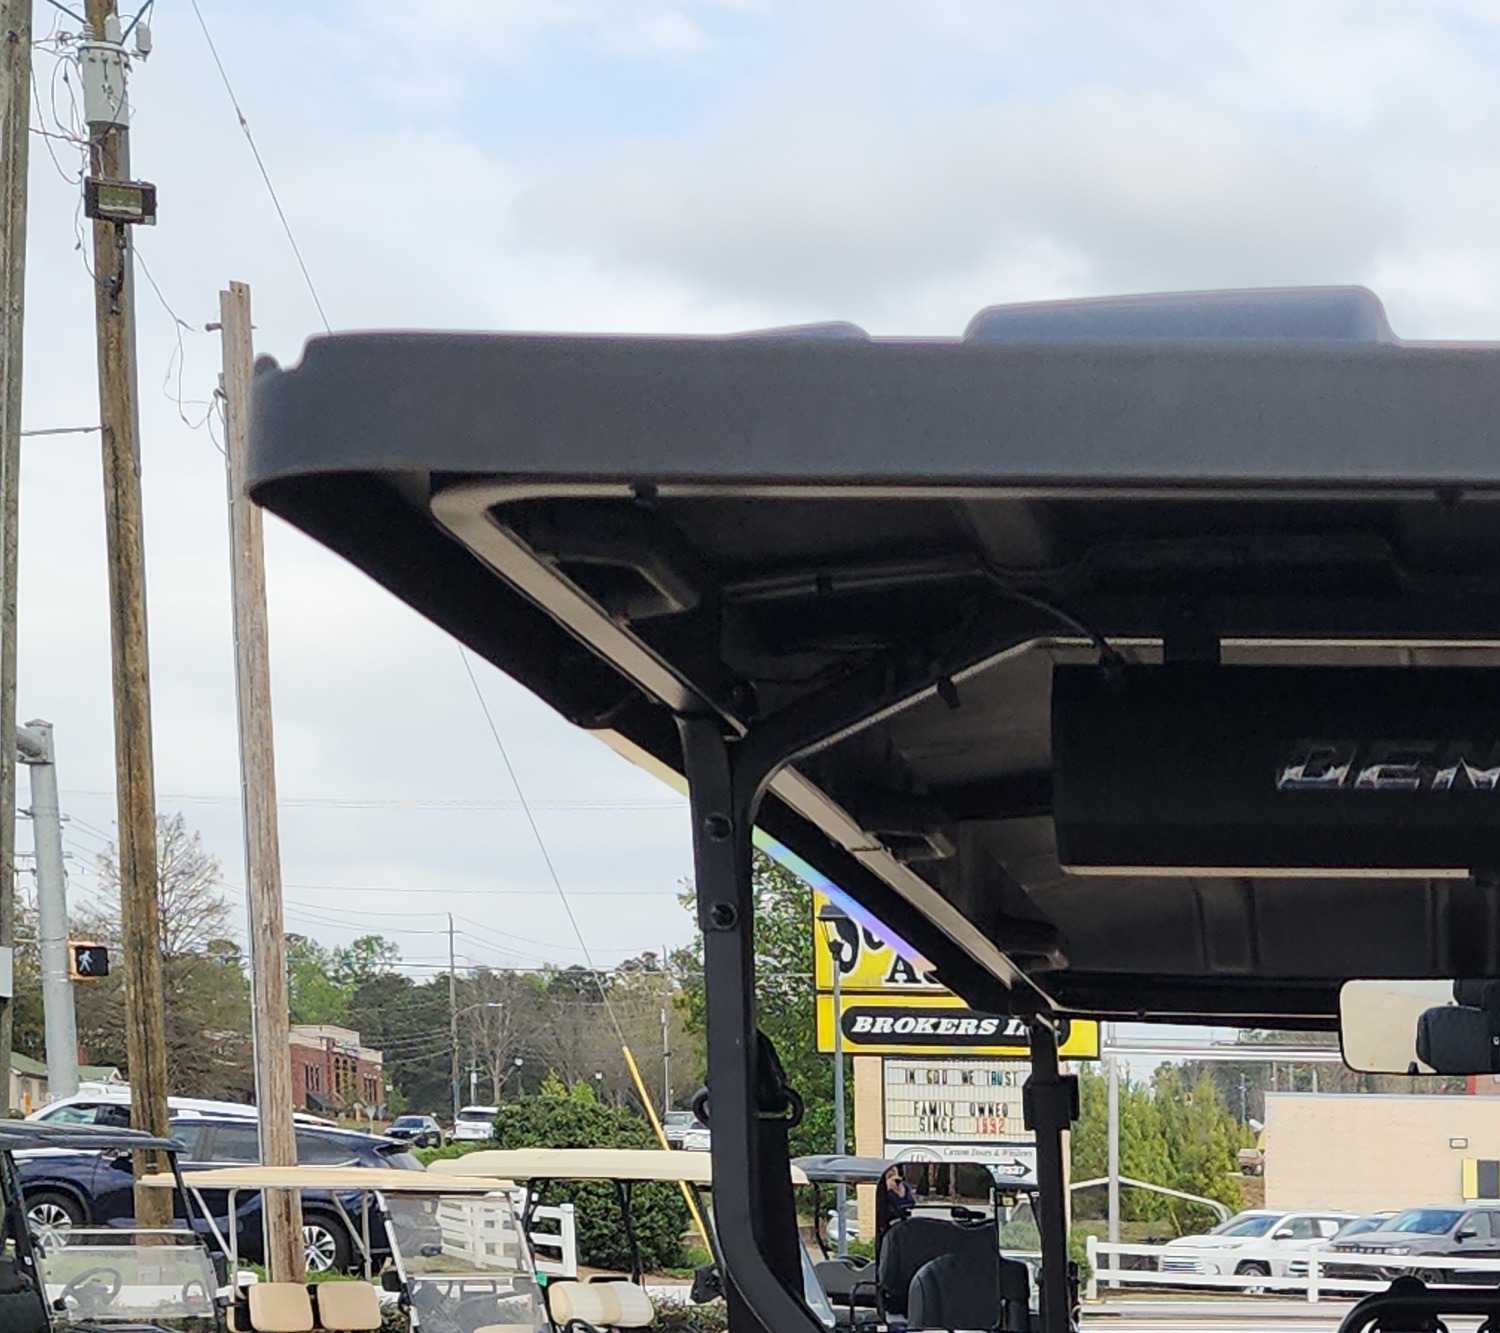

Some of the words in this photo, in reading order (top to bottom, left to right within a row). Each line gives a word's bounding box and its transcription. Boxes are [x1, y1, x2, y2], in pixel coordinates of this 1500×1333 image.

[851, 1015, 999, 1035] BROKERS
[905, 1069, 915, 1084] IN
[962, 1071, 974, 1085] WE
[986, 1071, 1017, 1086] TRUST
[914, 1101, 955, 1116] FAMILY
[969, 1102, 1008, 1118] OWNED
[920, 1117, 954, 1133] SINCE
